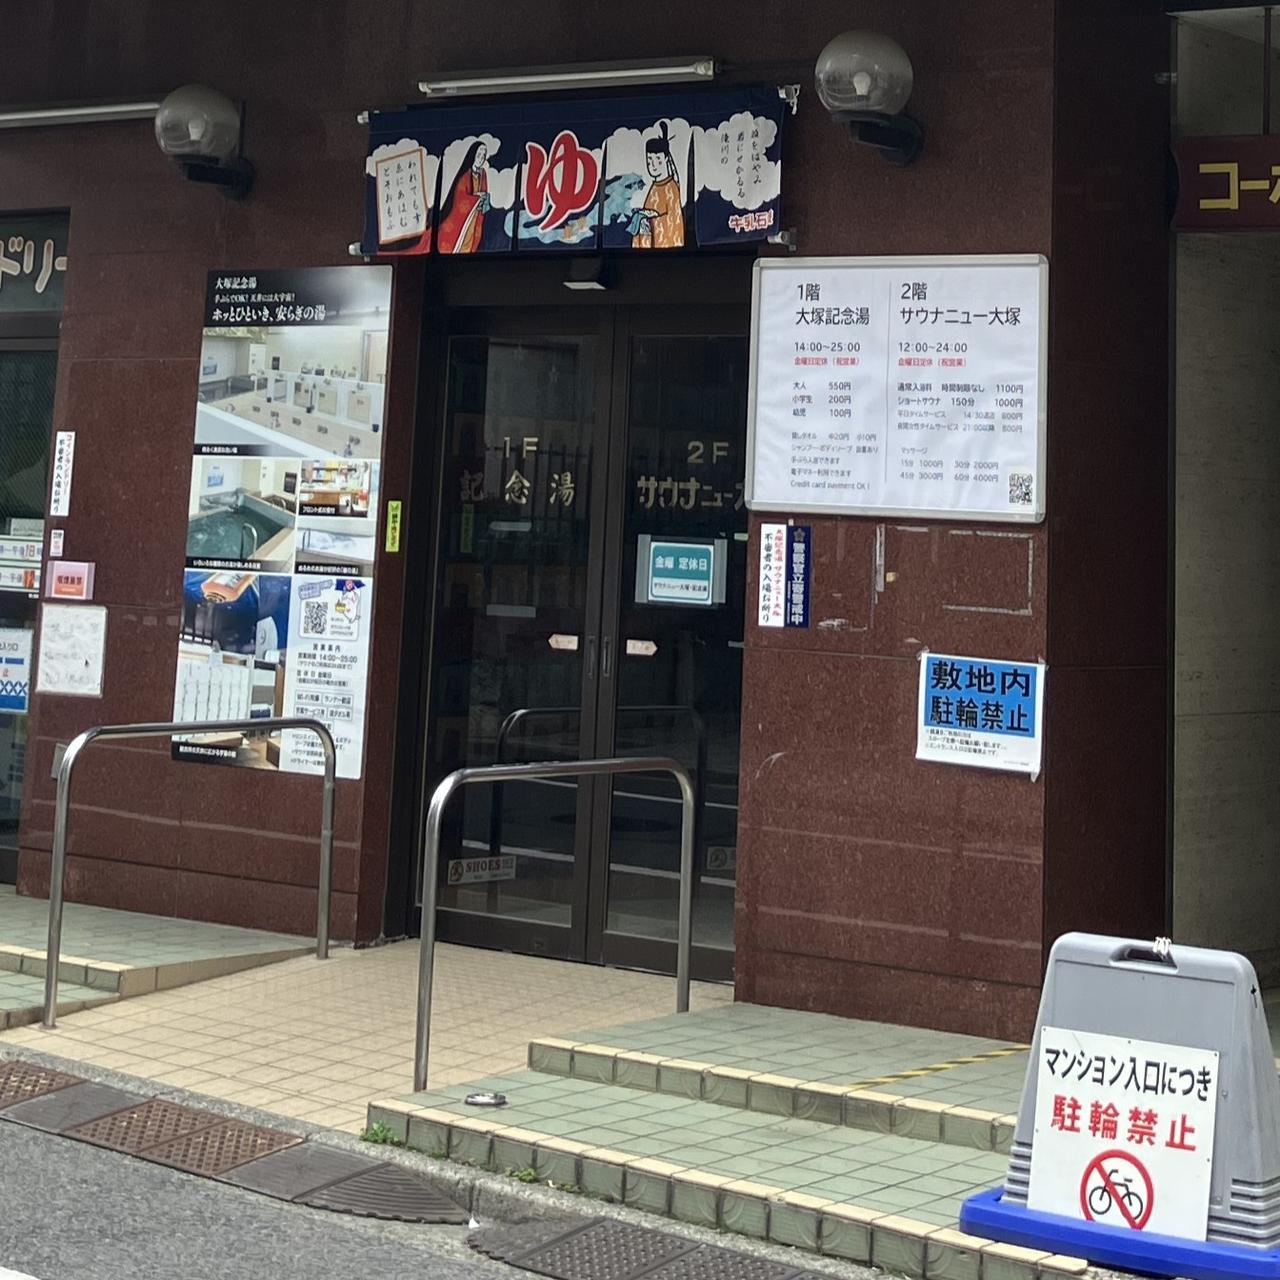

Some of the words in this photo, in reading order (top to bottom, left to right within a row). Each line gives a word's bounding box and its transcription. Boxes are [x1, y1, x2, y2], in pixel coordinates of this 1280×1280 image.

[524, 128, 602, 234] ゆ
[797, 282, 821, 302] 1階
[901, 282, 927, 301] 2階
[795, 306, 870, 326] 大塚記念湯
[900, 306, 1021, 326] サウナニュー大塚
[793, 381, 806, 391] 大人
[828, 381, 851, 391] 550円
[996, 384, 1024, 394] 1100円
[792, 394, 813, 404] 小学生
[828, 394, 851, 404] 200円
[951, 397, 975, 407] 150分
[995, 398, 1024, 408] 1000円
[830, 408, 852, 418] 100円
[503, 436, 538, 459] 1F
[686, 440, 730, 464] 2F
[460, 470, 575, 507] 記念湯
[678, 556, 708, 572] 定休日
[930, 659, 1032, 698] 敷地内
[929, 694, 1030, 733] 駐輪禁止
[1044, 1046, 1213, 1102] マンション入口につき
[1050, 1094, 1197, 1152] 駐輪禁止
